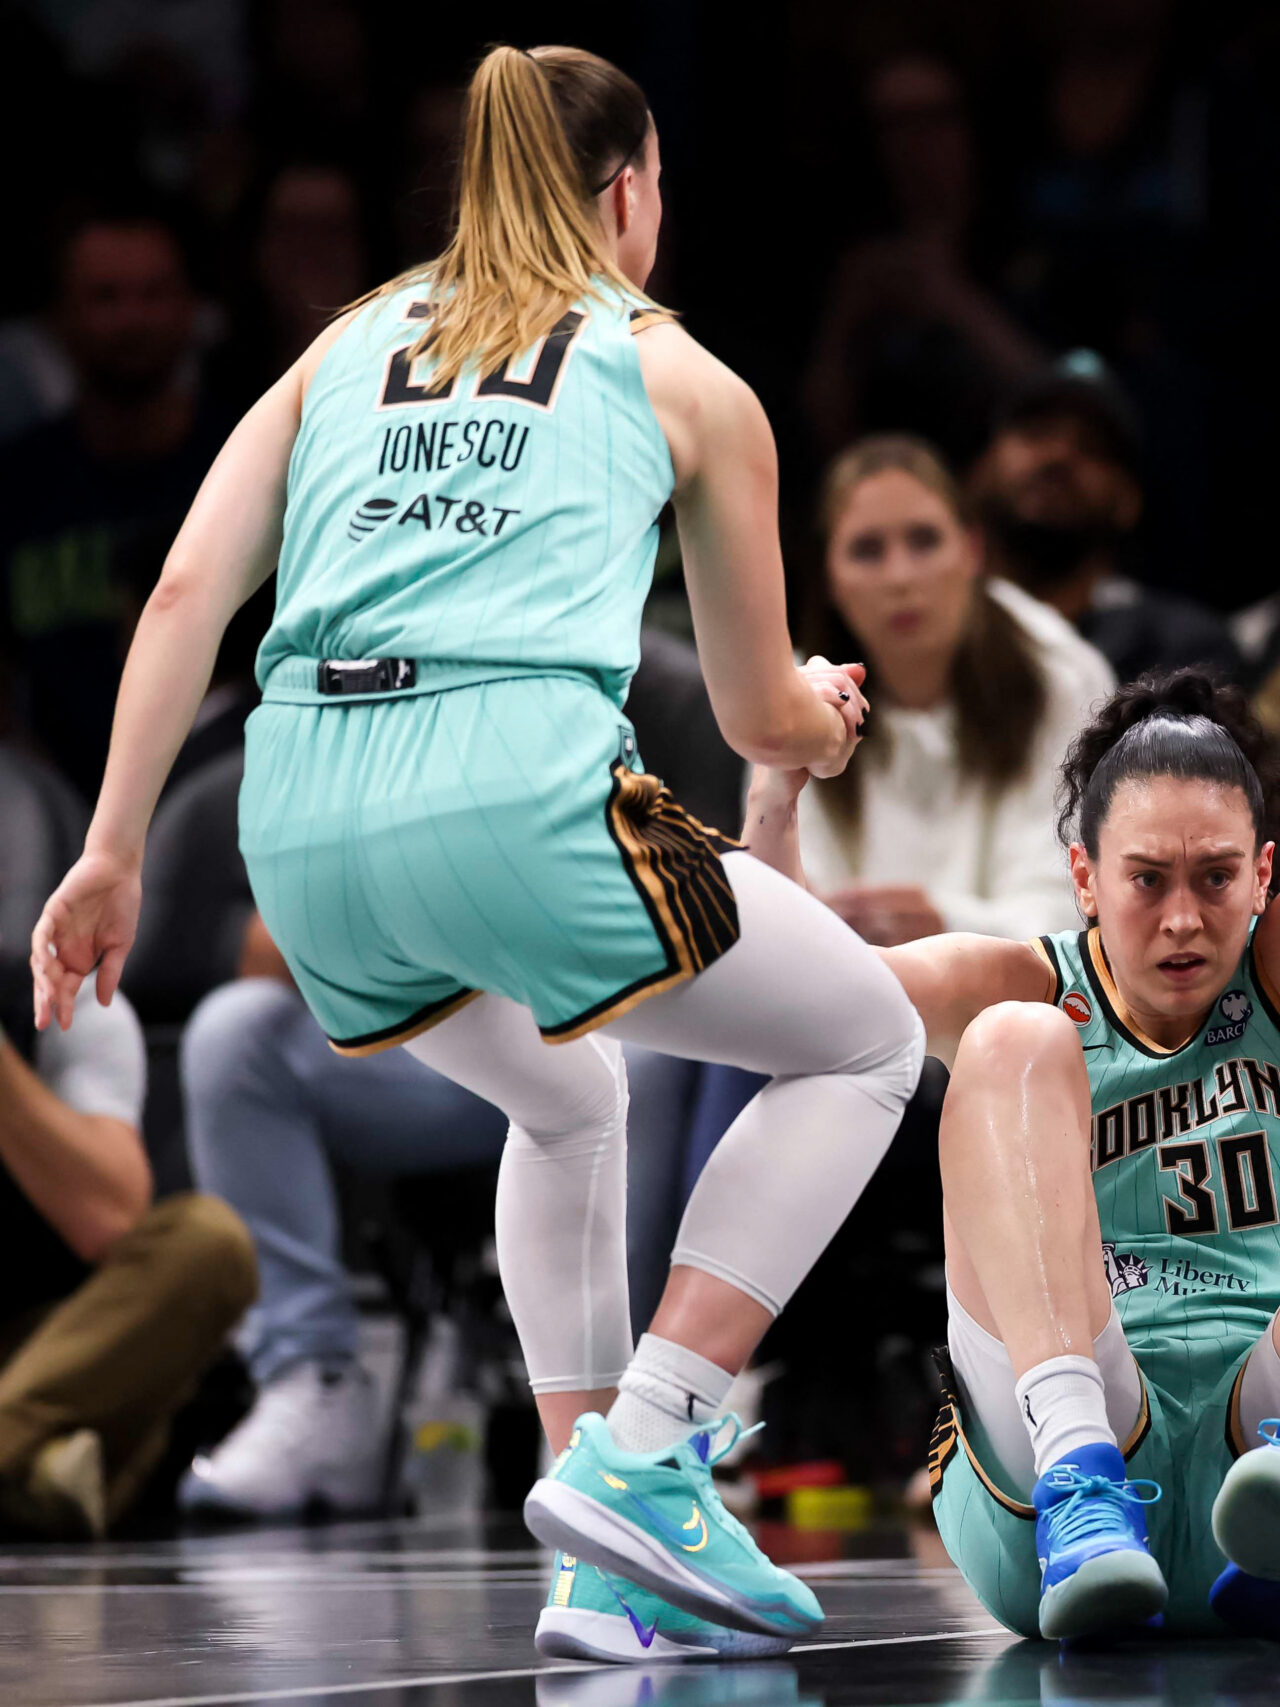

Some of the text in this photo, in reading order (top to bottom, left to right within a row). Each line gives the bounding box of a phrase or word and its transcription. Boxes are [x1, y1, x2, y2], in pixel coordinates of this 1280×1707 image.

[378, 419, 529, 475] IONESCU
[398, 493, 521, 536] AT&T
[1157, 1130, 1280, 1237] 30
[1160, 1258, 1251, 1292] Liberty
